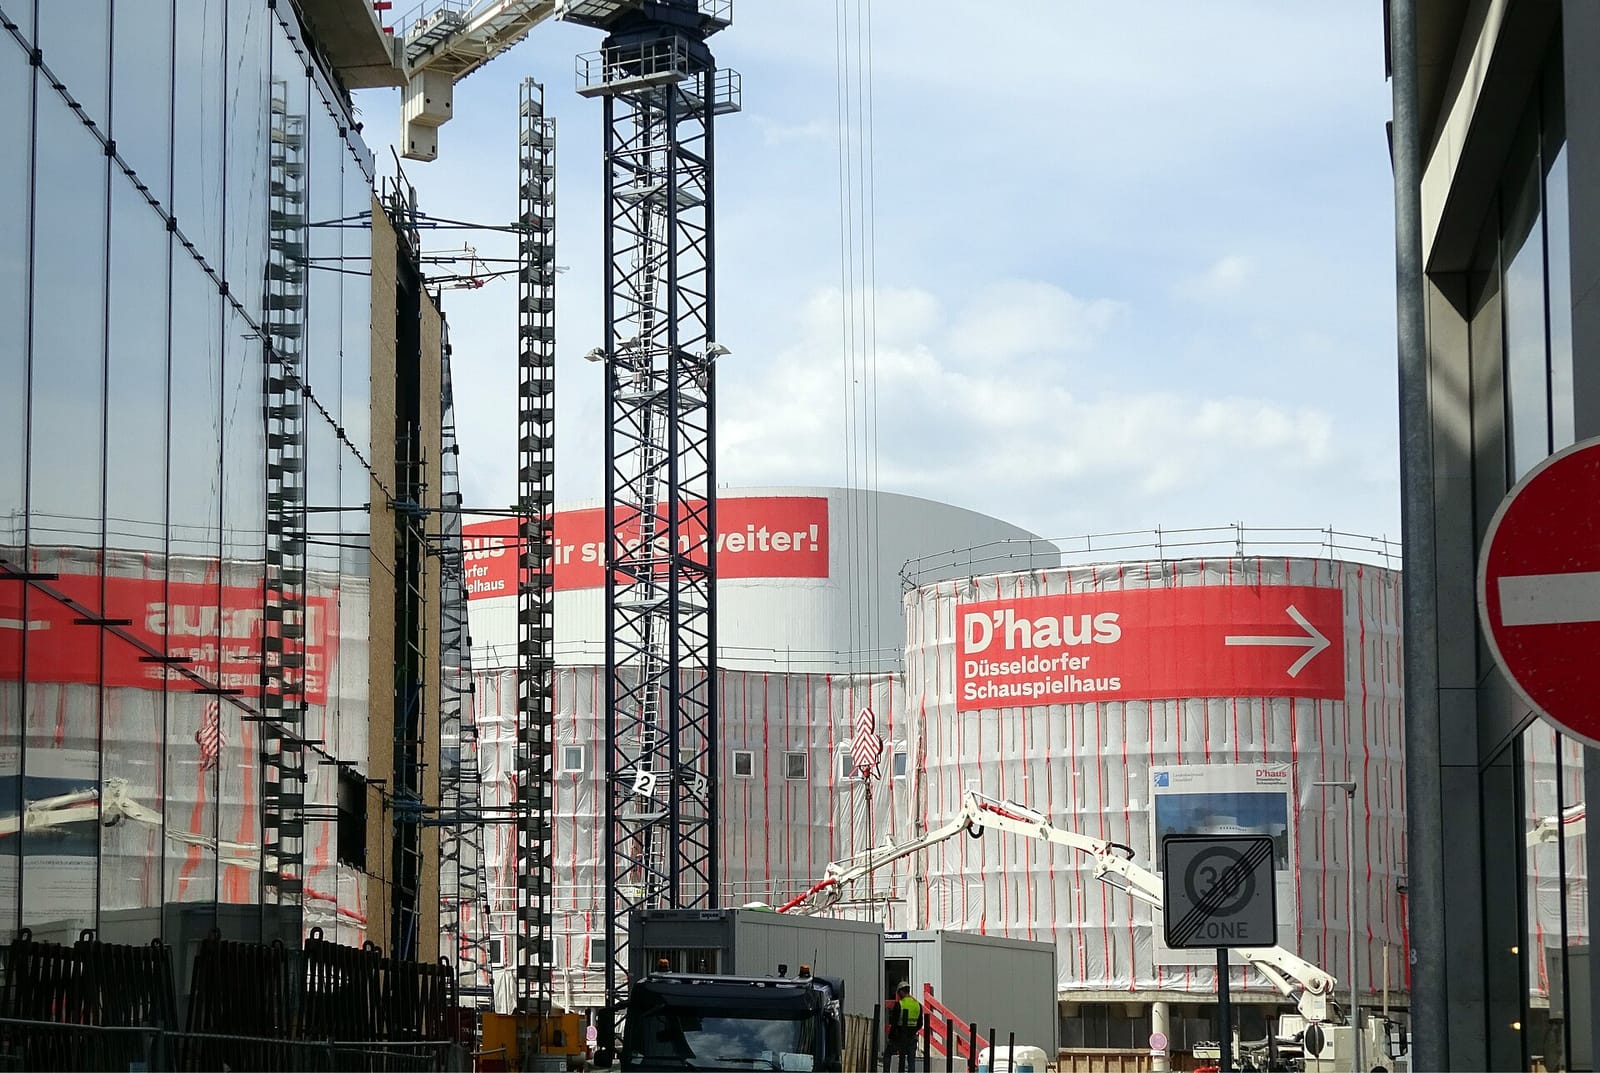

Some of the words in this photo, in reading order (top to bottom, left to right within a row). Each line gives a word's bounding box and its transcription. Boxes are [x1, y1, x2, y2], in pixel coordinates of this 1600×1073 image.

[463, 537, 505, 561] aus
[699, 524, 819, 554] weiter!
[963, 608, 1122, 654] D'haus
[963, 653, 1091, 679] Düsseldorfer
[963, 675, 1122, 701] Schauspielhaus
[637, 775, 651, 793] 2
[696, 779, 704, 796] 2
[1195, 921, 1249, 939] ZONE
